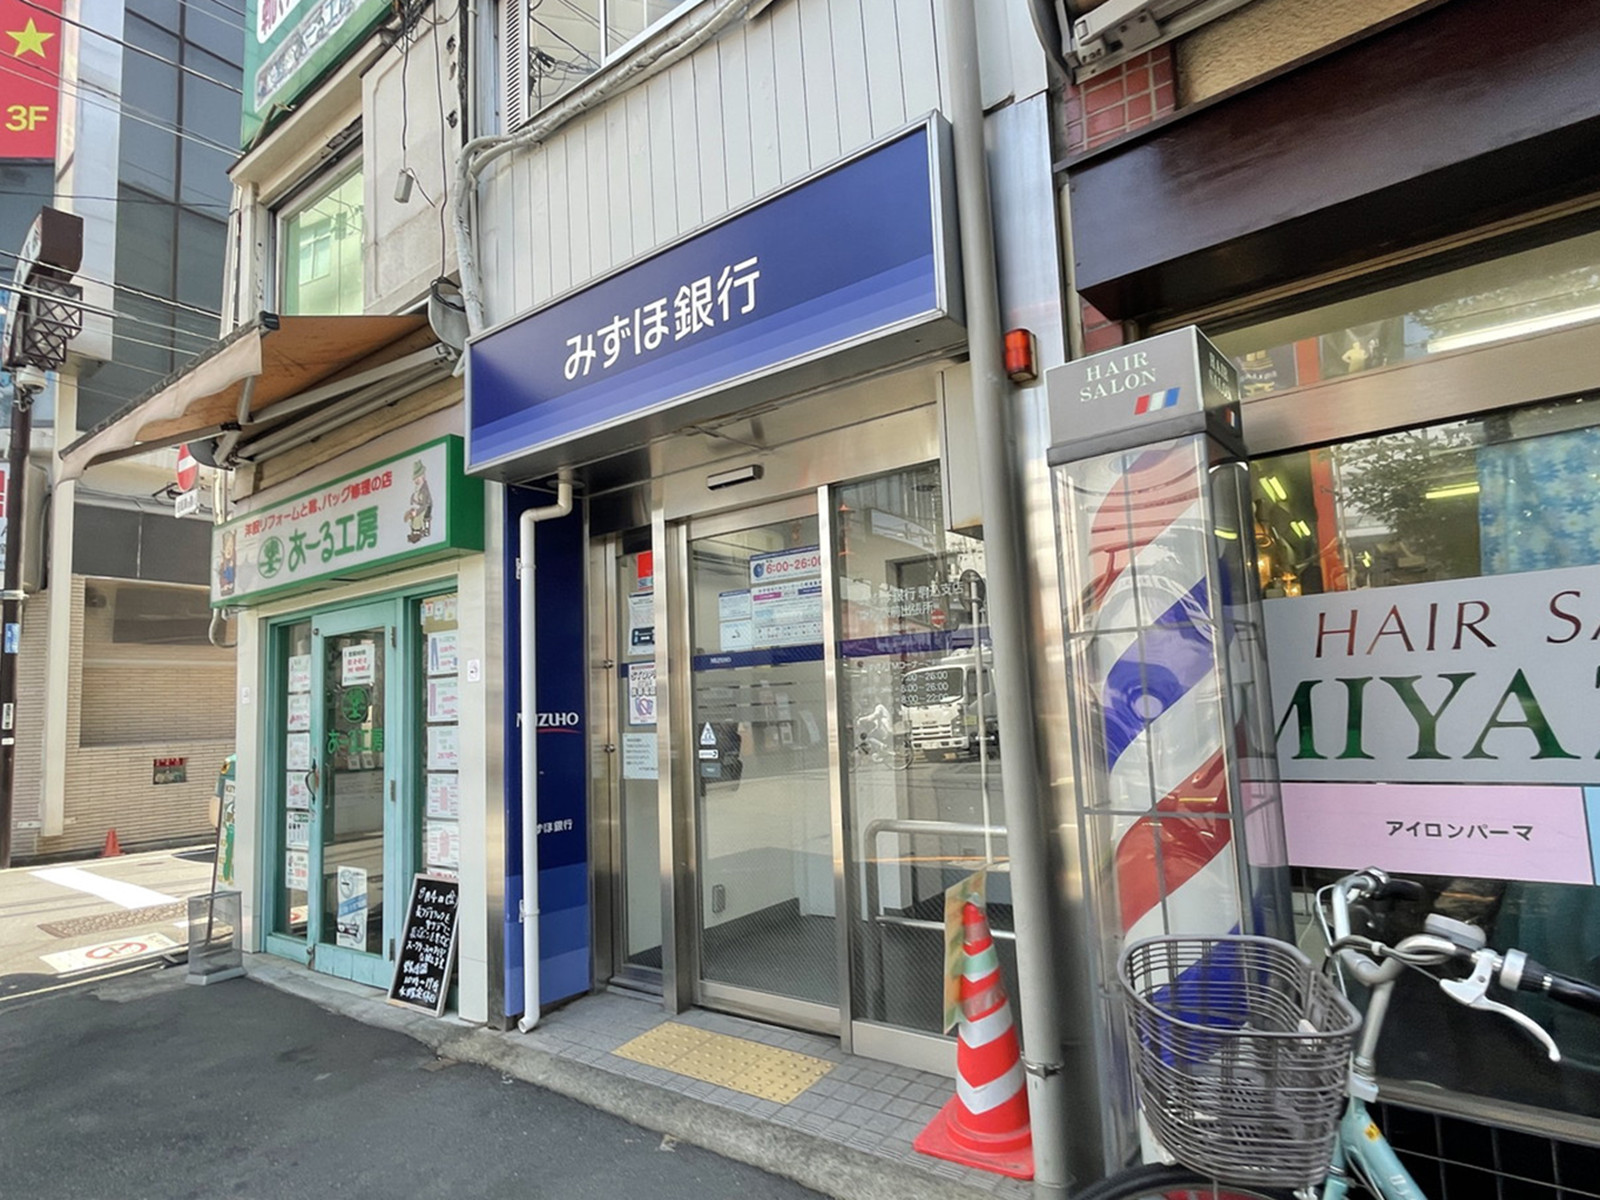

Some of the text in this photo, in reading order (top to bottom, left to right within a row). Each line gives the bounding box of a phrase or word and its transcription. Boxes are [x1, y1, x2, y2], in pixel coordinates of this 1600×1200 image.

[5, 105, 49, 132] 3F
[564, 256, 761, 381] みずほ銀行
[1086, 351, 1148, 383] HAIR
[1208, 352, 1229, 383] HAIR
[1080, 367, 1158, 403] SALON
[1208, 369, 1233, 402] SALON
[1315, 590, 1600, 658] HAIR S
[1233, 667, 1600, 760] MIYA
[1385, 820, 1534, 841] アイロンパーマ
